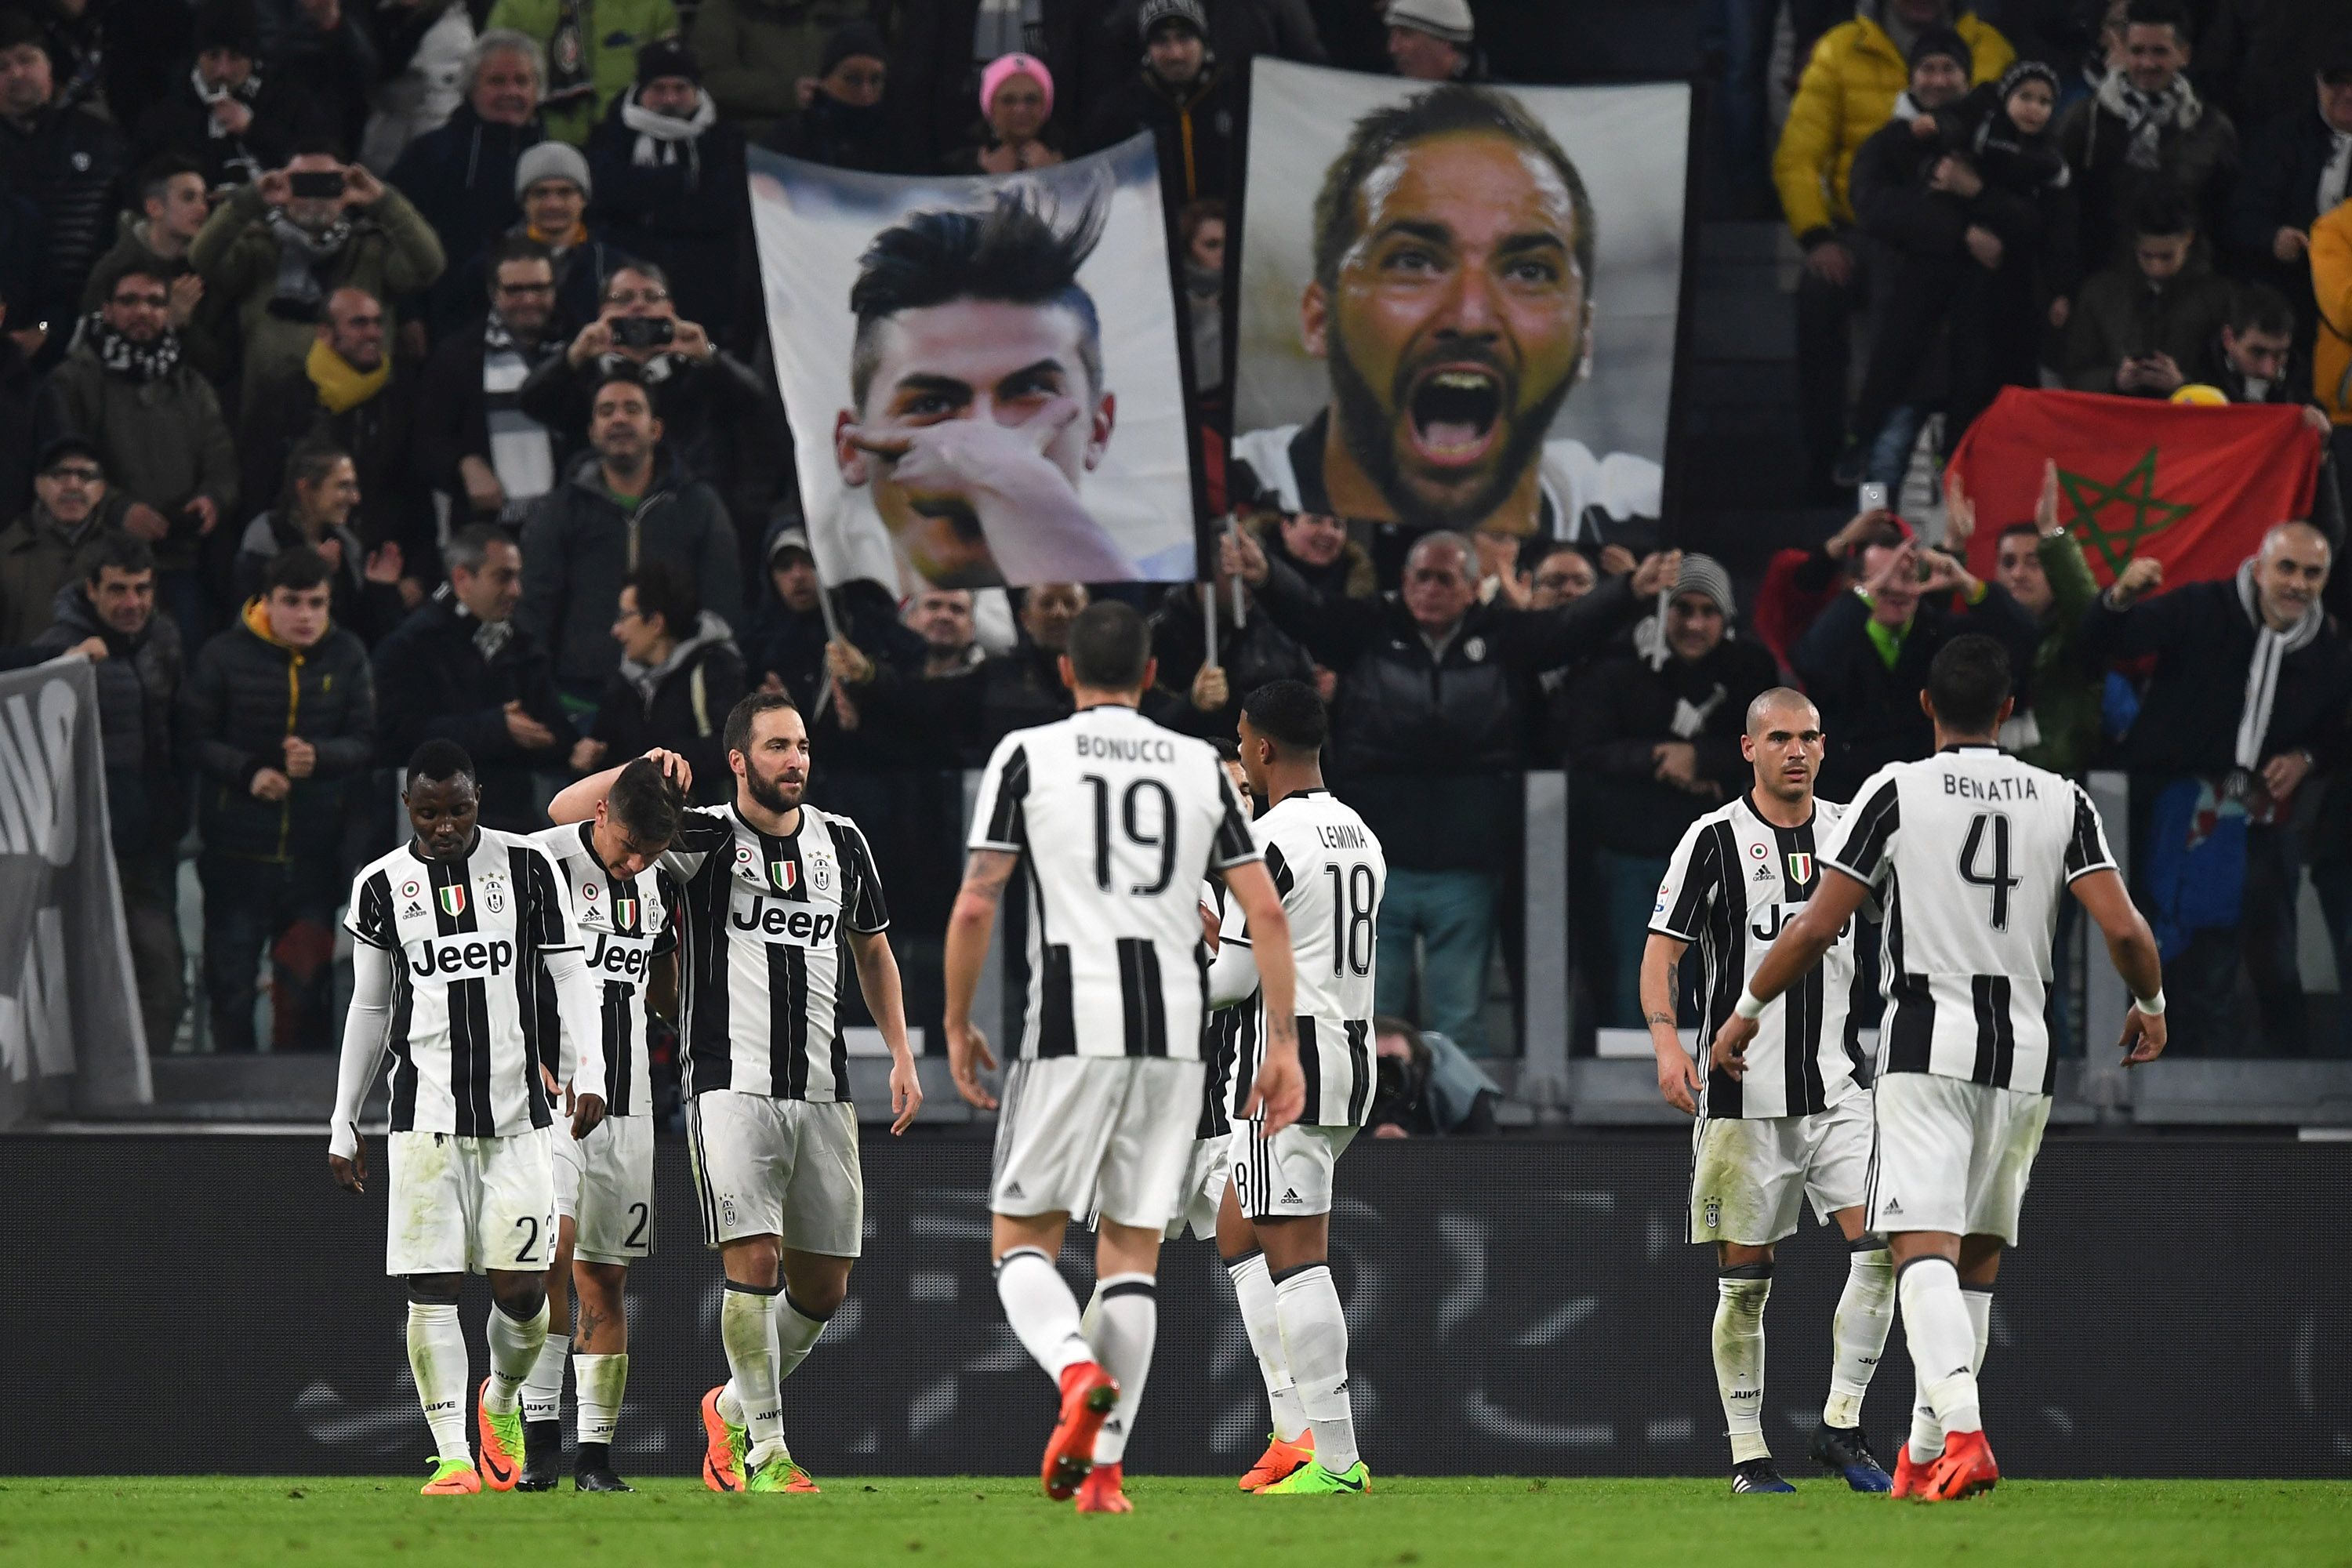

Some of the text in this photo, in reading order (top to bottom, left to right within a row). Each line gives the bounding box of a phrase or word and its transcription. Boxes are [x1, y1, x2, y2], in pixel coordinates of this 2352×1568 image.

[1075, 734, 1175, 763] BONUCCI
[1944, 774, 2038, 801] BENATIA
[1080, 771, 1179, 899] 19
[1316, 825, 1368, 850] LEMINA
[1956, 811, 2024, 933] 4
[402, 909, 427, 920] adidas
[732, 895, 834, 947] Jeep
[1323, 862, 1377, 978] 18
[412, 939, 512, 977] Jeep
[424, 1401, 456, 1412] JUVE
[1730, 1388, 1762, 1399] JUVE
